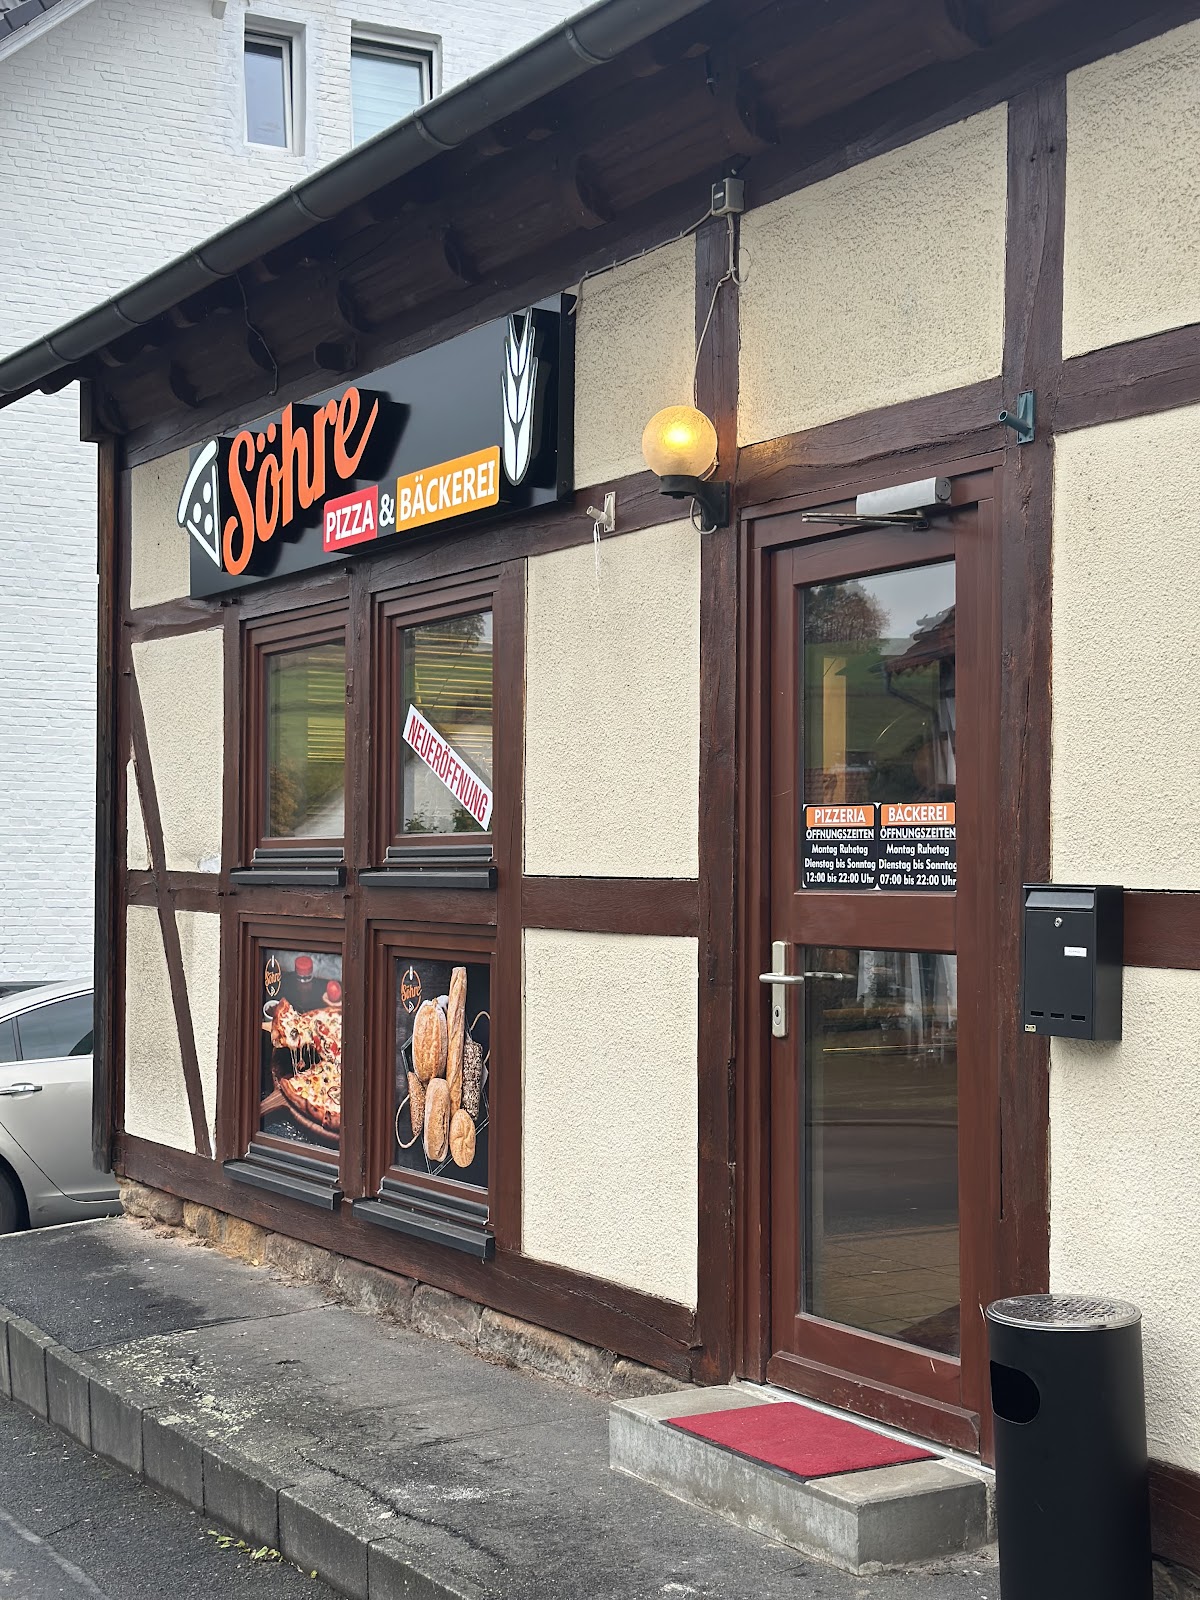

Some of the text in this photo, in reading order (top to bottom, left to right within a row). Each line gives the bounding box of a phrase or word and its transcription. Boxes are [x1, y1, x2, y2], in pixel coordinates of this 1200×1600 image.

[222, 386, 379, 577] Söhre
[325, 459, 496, 544] PIZZA & BÄCKEREI
[407, 715, 489, 822] NEUERÖFFNUNG
[814, 808, 866, 823] PIZZERIA
[888, 803, 947, 821] BÄCKEREI
[805, 827, 875, 840] ÖFFNUNGSZEITEN
[880, 826, 956, 839] ÖFFNUNGSZEITEN
[811, 844, 868, 856] Montag Ruhetag
[886, 843, 950, 856] Montag Ruhetag
[805, 858, 876, 871] Dienstag bis Sonntag
[879, 859, 911, 872] Dienstag
[913, 859, 924, 870] bis
[806, 872, 875, 884] 12:00 bis 22:00 Uhr
[880, 874, 957, 886] 07:00 bis 22:00 Uhr
